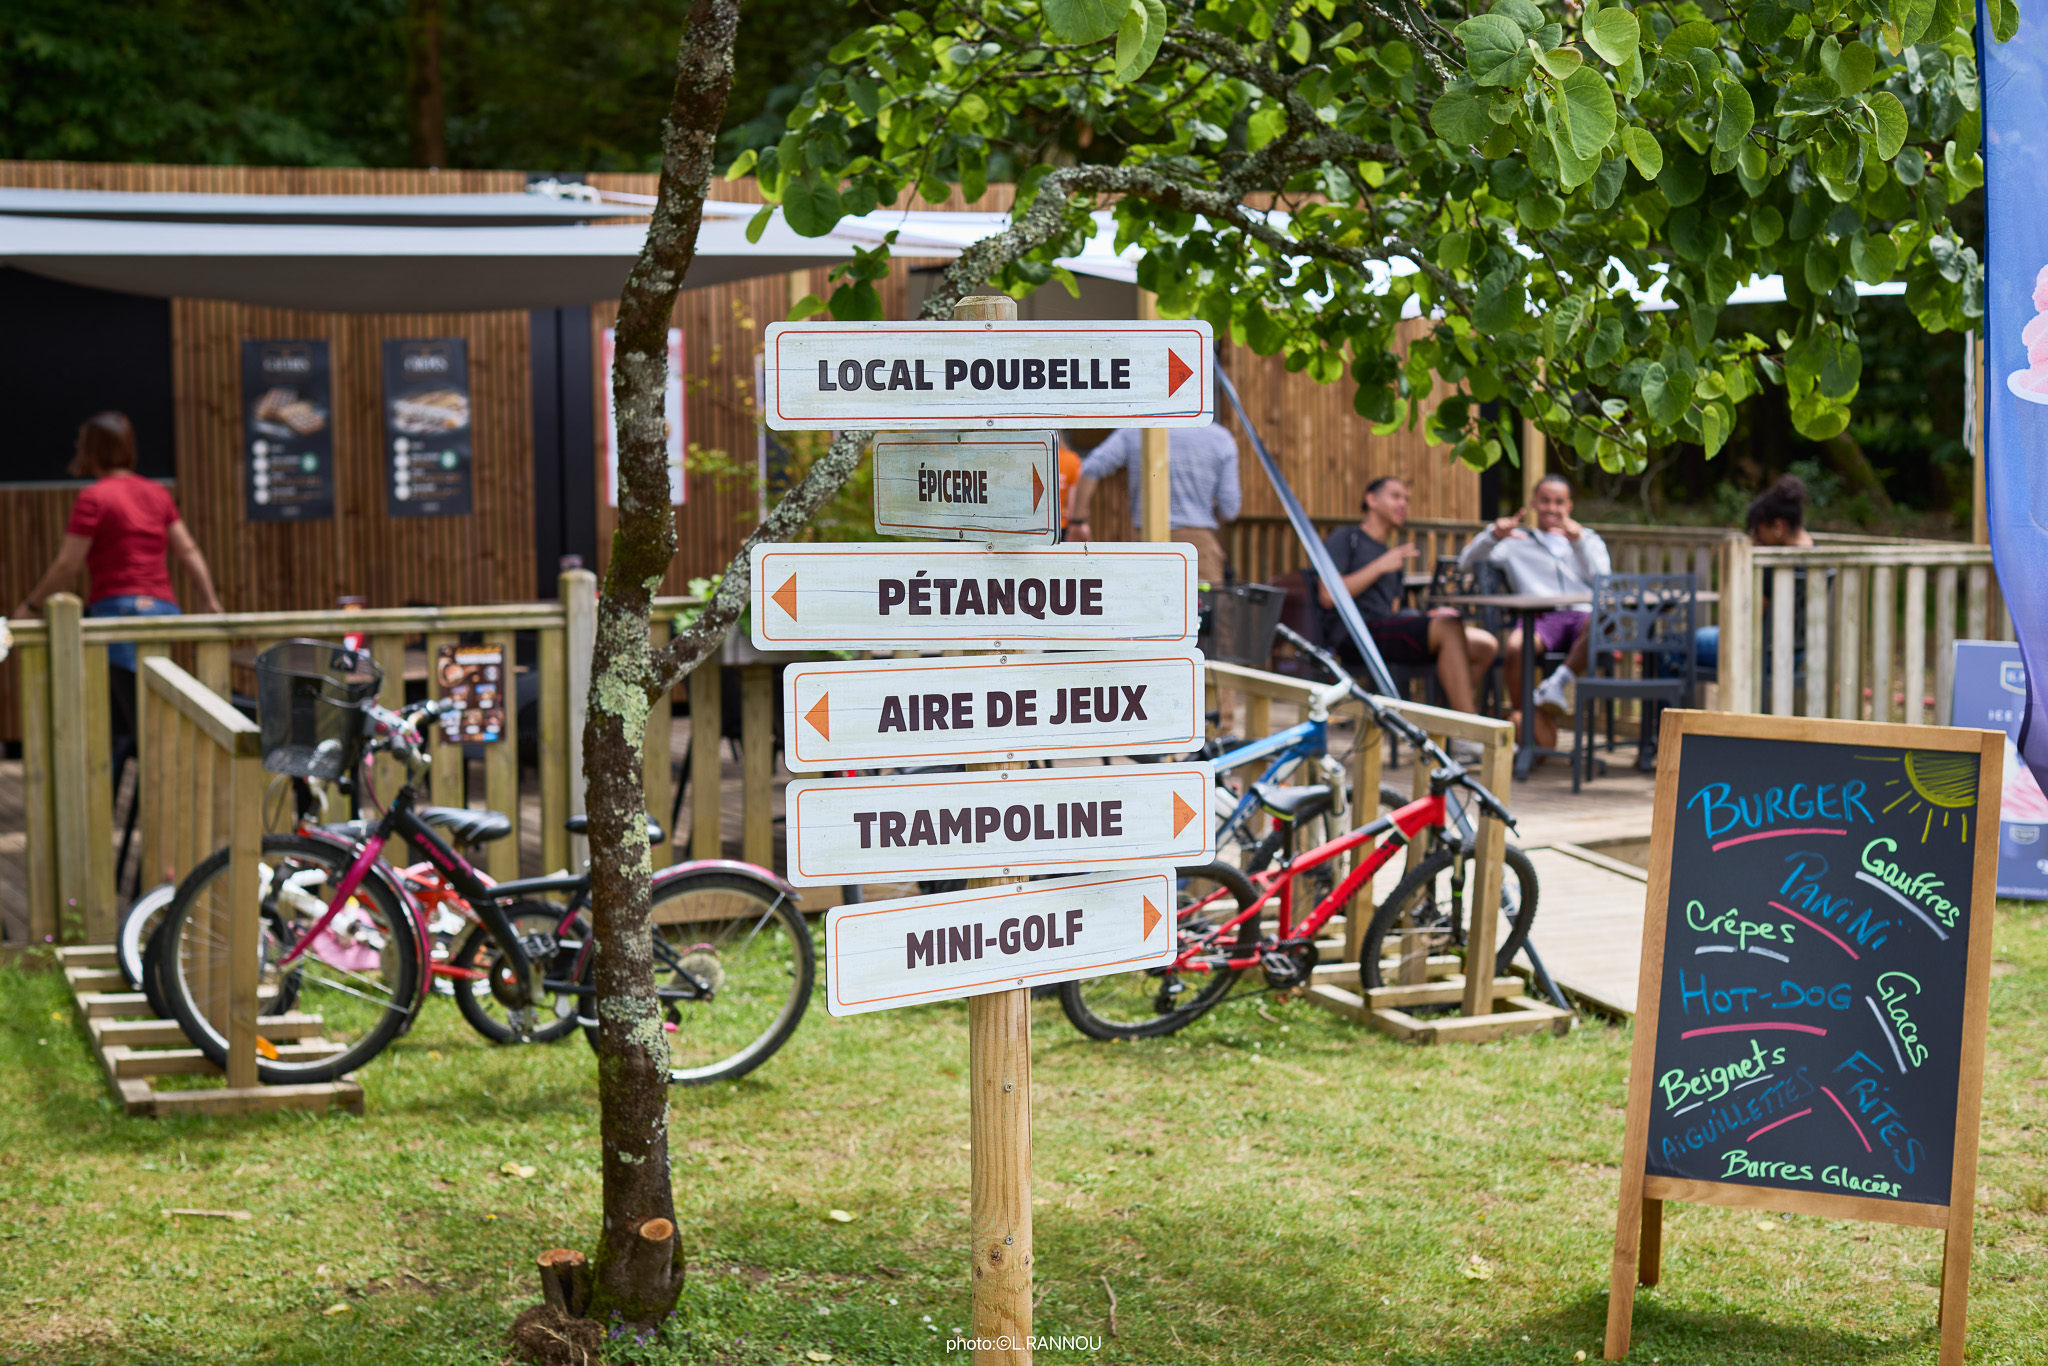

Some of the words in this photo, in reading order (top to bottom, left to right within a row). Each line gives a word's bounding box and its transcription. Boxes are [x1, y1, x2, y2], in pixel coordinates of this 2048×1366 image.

[818, 359, 934, 392] LOCAL
[945, 357, 1131, 391] POUBELLE
[918, 462, 989, 505] ÉPICERIE
[878, 569, 1104, 620] PÉTANQUE
[878, 691, 974, 734] AIRE
[986, 689, 1038, 728] DE
[1049, 684, 1148, 726] JEUX
[853, 799, 1123, 850] TRAMPOLINE
[1686, 779, 1875, 840] BURGER
[1861, 837, 1961, 929] Gauffres
[906, 908, 1084, 970] MINI-GOLF
[1685, 899, 1796, 951] Crêpes
[1679, 968, 1853, 1016] HOT-DOG
[1875, 970, 1930, 1068] Glaces
[1658, 1038, 1787, 1112] Beignets
[1720, 1149, 1814, 1182] Barres
